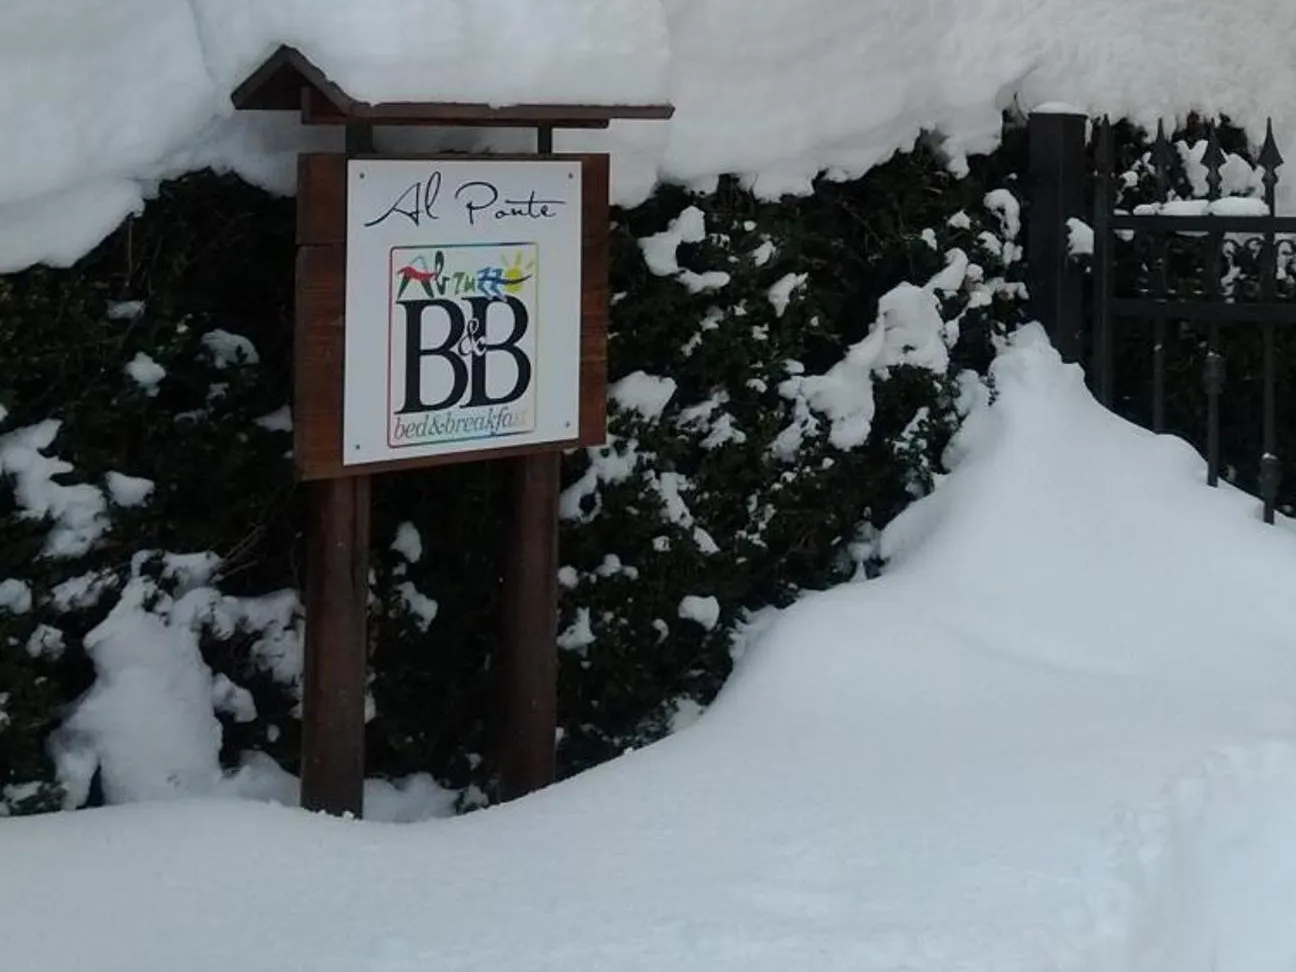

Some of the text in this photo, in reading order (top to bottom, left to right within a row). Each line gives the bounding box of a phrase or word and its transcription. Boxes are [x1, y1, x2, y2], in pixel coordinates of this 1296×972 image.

[365, 171, 566, 226] Al Ponte
[395, 295, 532, 415] B&B
